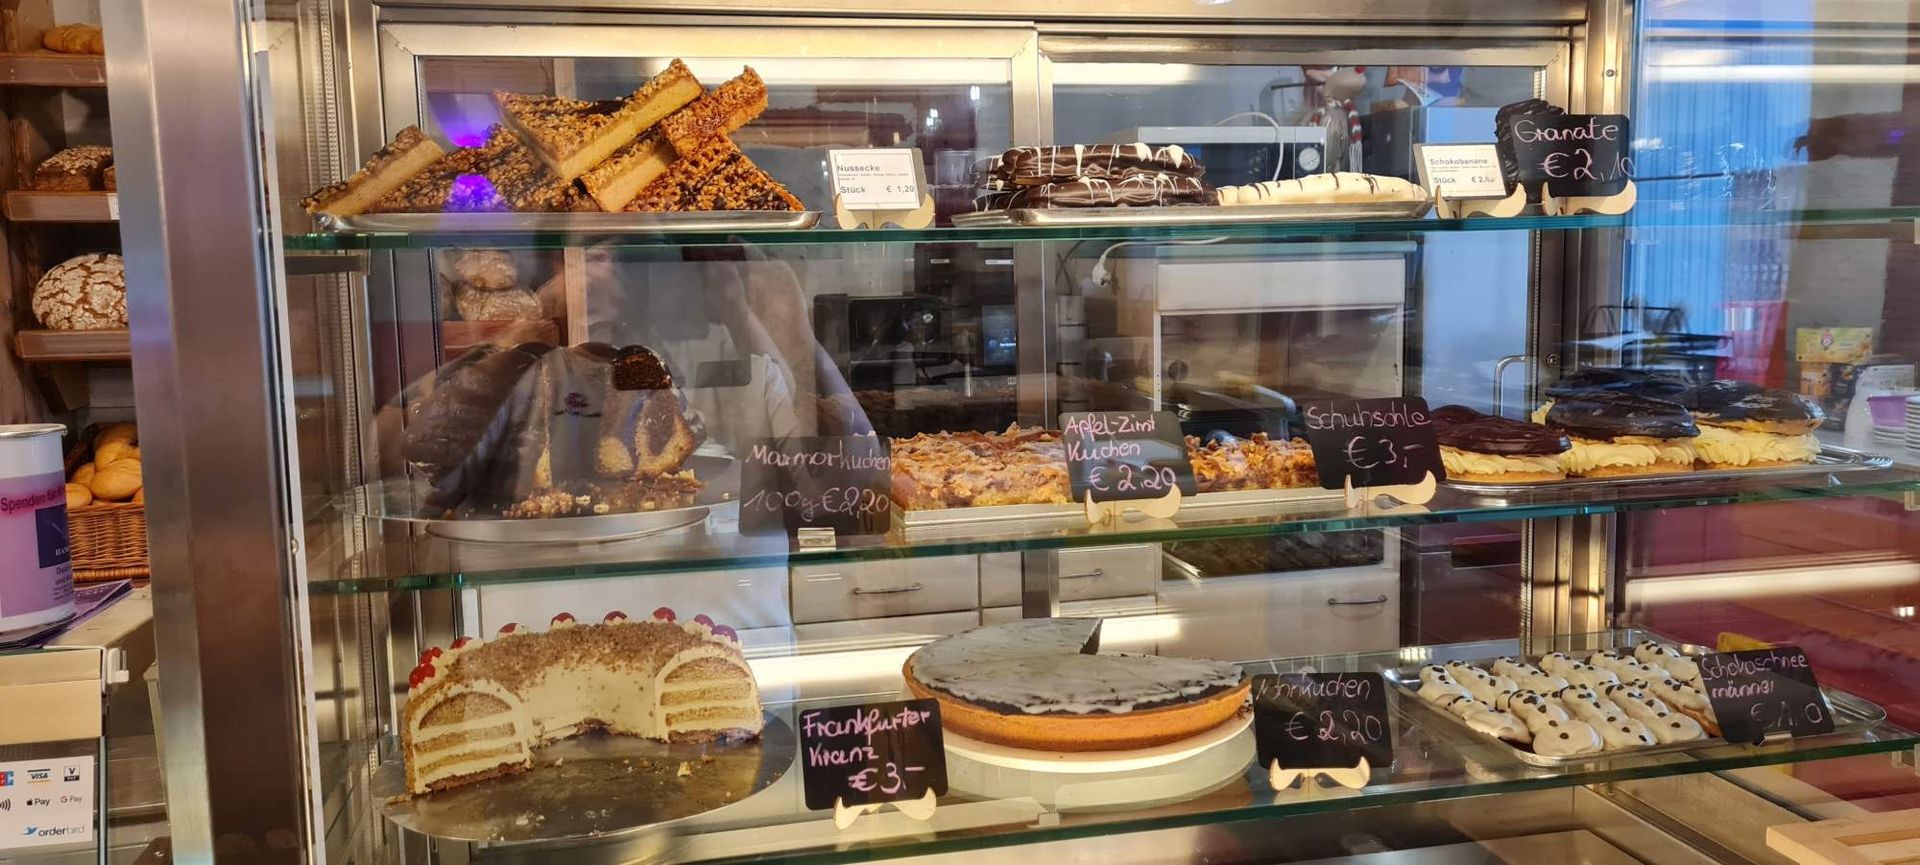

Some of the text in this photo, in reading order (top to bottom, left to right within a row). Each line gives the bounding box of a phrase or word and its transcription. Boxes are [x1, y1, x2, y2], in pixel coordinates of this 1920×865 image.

[1514, 116, 1619, 143] Granate
[837, 164, 880, 172] Nussecke
[1430, 158, 1488, 166] Schokobanane
[1433, 176, 1456, 184] Stück
[840, 185, 866, 194] Stück
[897, 185, 915, 194] 1,20
[1307, 401, 1432, 431] Schuhsohle
[1064, 413, 1156, 442] Apfel-Zimt
[745, 439, 891, 470] Marmorkuchen
[1067, 440, 1141, 462] Kuchen
[0, 493, 46, 514] Spenden
[802, 707, 930, 746] Frankfurter
[809, 742, 880, 768] Kranz
[31, 772, 49, 780] VISA
[34, 798, 51, 807] Pay
[69, 794, 83, 804] Pay
[38, 825, 85, 837] orderbird
